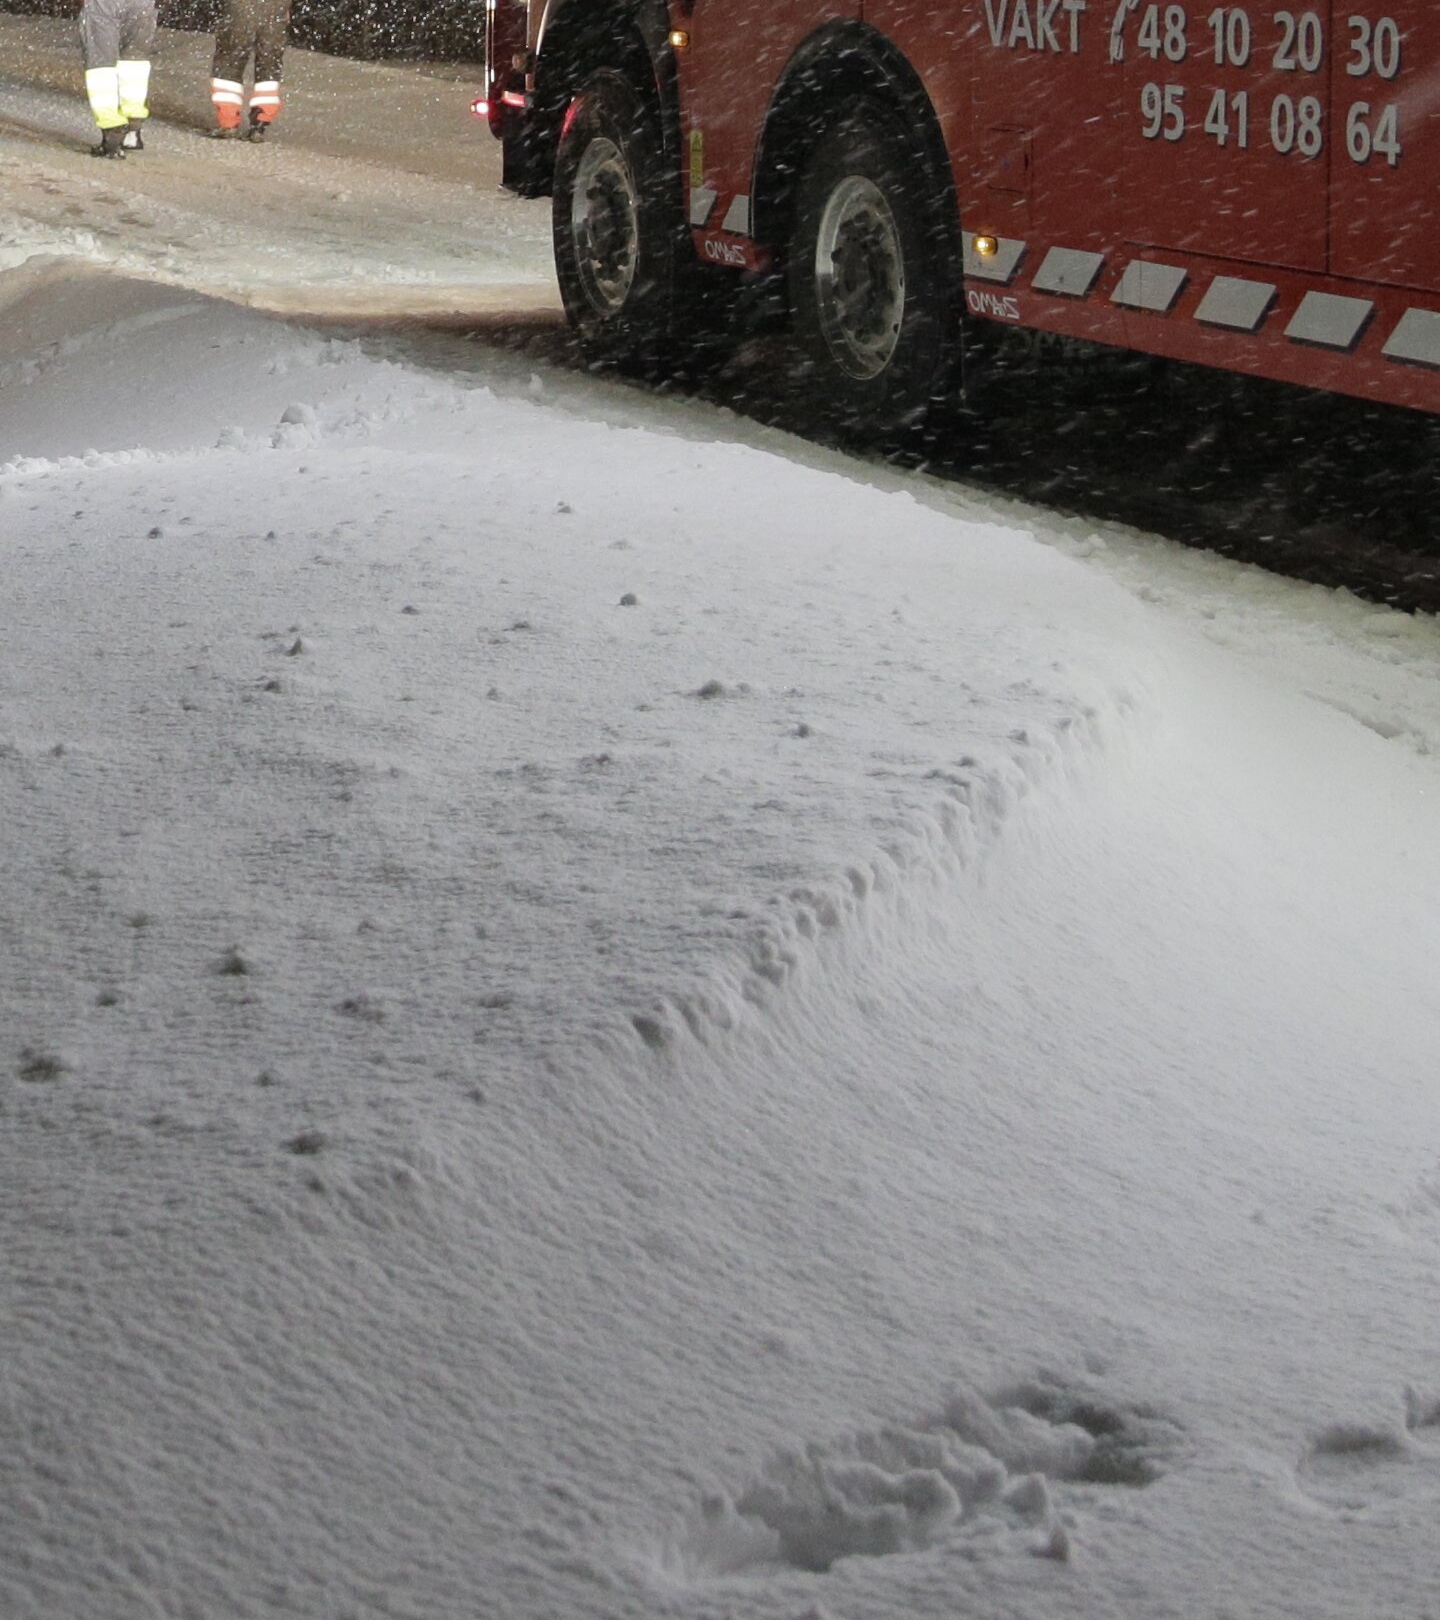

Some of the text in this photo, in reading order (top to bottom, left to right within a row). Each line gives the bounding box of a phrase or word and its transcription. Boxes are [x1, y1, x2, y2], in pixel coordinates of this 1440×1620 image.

[1137, 4, 1188, 62] 48
[1208, 7, 1251, 66] 10
[1272, 11, 1321, 72] 20
[1346, 14, 1400, 79] 30
[1140, 82, 1401, 166] 95 41 08 64
